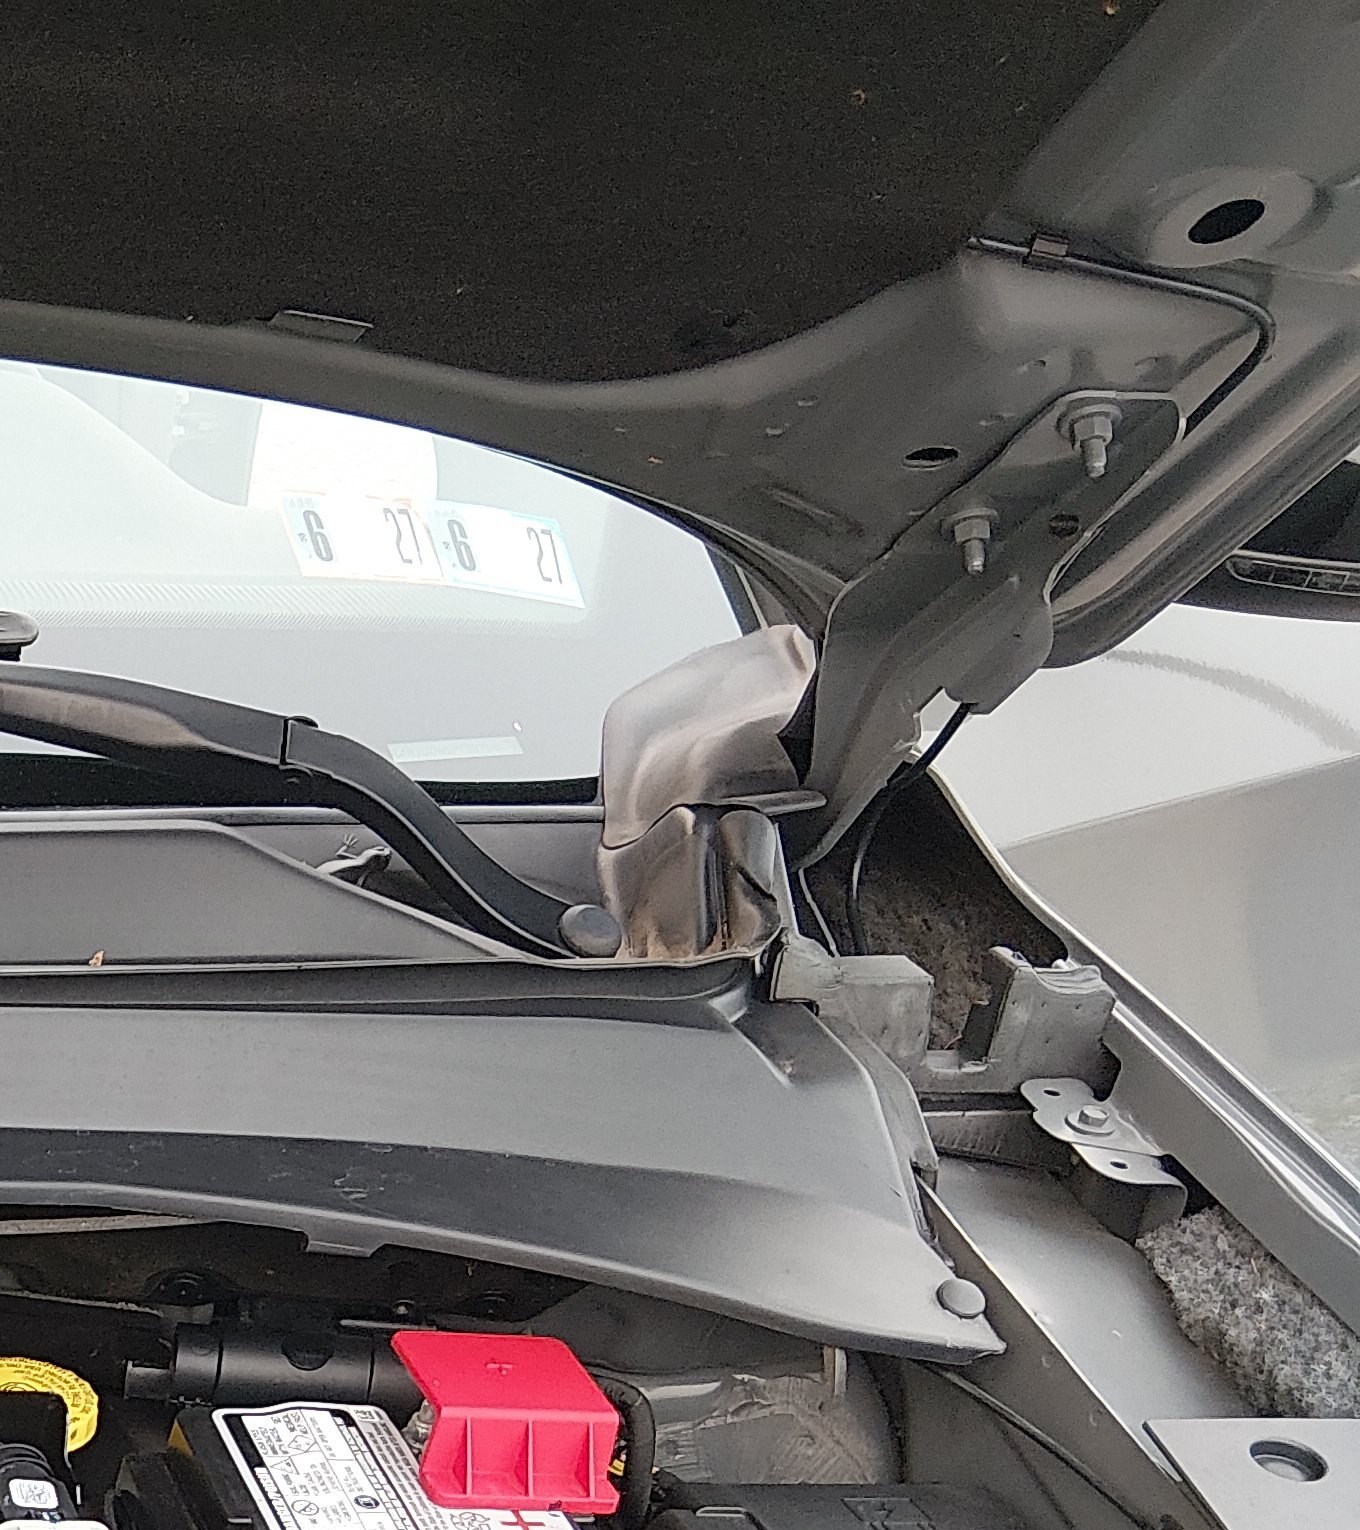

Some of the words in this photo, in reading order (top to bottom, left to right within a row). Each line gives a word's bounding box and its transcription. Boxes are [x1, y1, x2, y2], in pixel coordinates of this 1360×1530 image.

[302, 508, 334, 562] 6
[382, 507, 423, 565] 27
[447, 519, 476, 572] 6
[526, 526, 563, 584] 27
